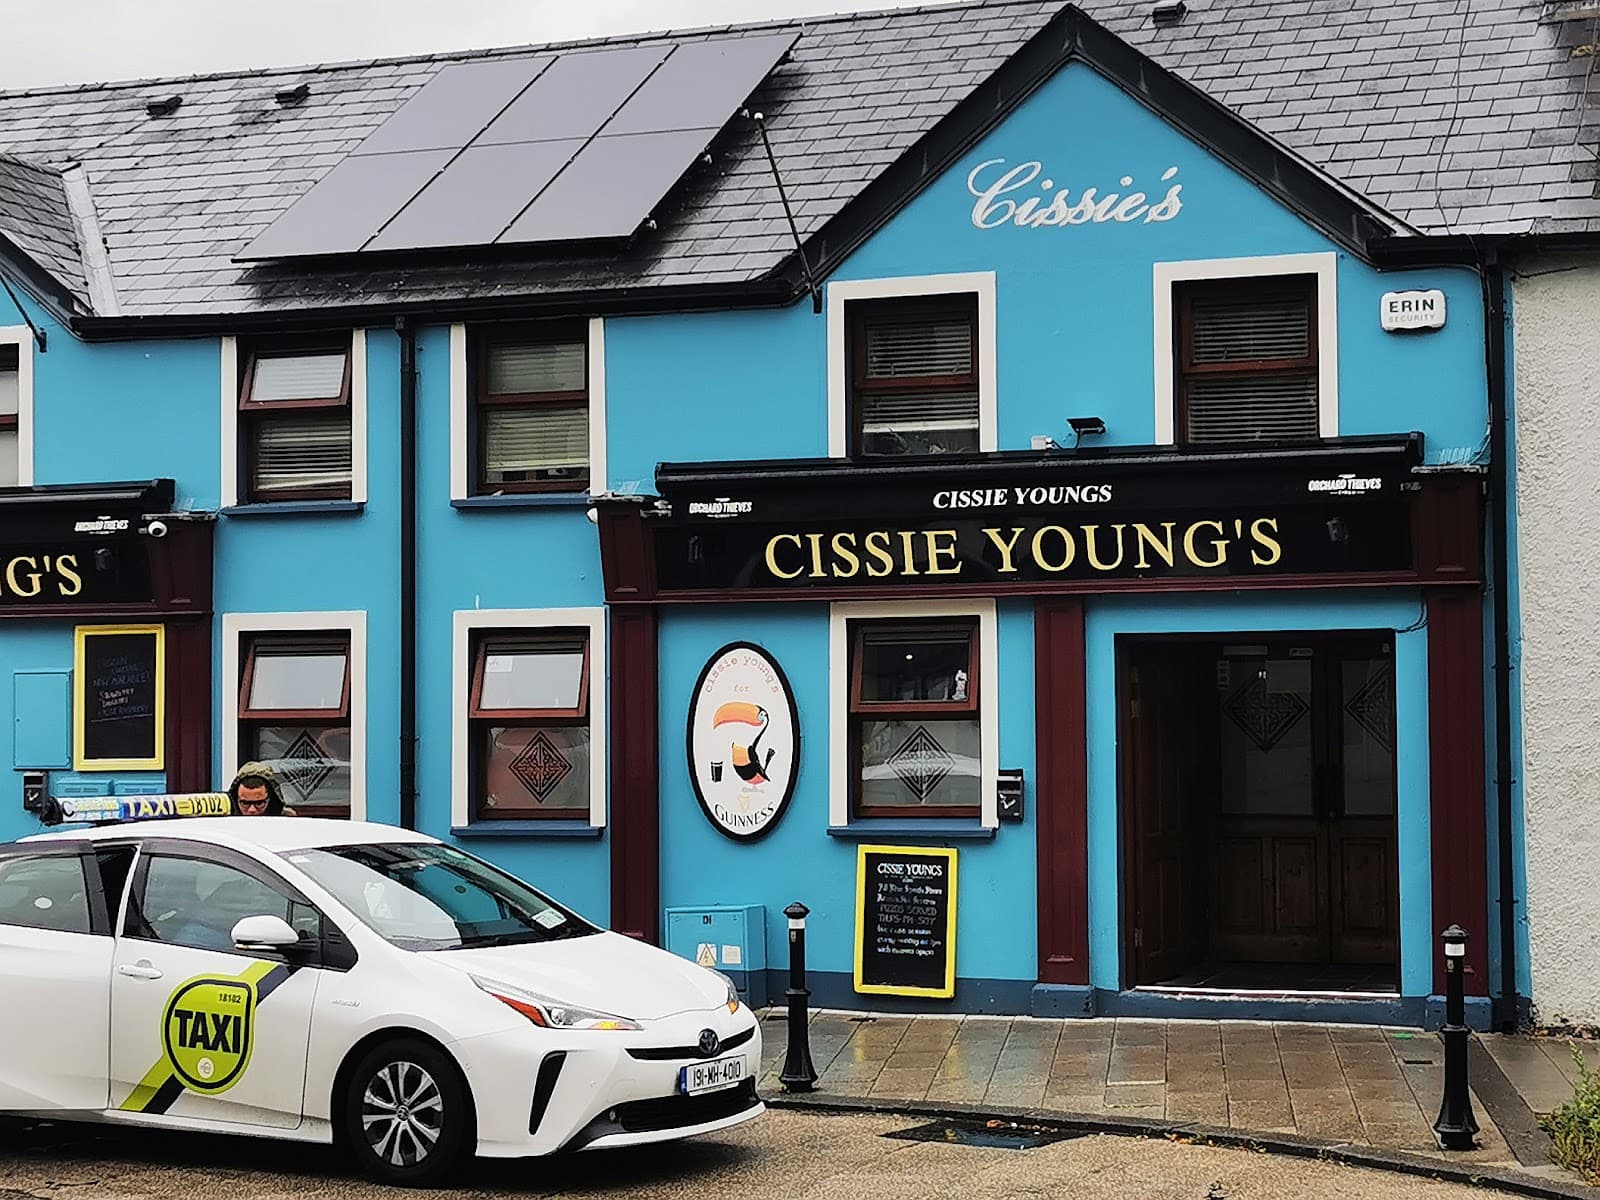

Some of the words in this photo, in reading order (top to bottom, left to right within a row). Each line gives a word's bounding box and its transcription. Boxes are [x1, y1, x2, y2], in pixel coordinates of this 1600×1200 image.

[967, 158, 1183, 229] Cissie's
[1389, 298, 1435, 313] ERIN
[1388, 313, 1436, 323] SECURITY
[1347, 477, 1382, 490] THIEVES
[932, 488, 1008, 509] CISSIE
[1015, 484, 1113, 505] YOUNGS
[765, 530, 963, 579] CISSIE
[982, 517, 1282, 574] YOUNG'S
[0, 554, 82, 598] G'S
[705, 655, 738, 694] cissie
[743, 655, 780, 694] young's
[733, 684, 751, 693] for
[124, 797, 175, 818] TAXI
[188, 795, 223, 815] 18102
[714, 801, 775, 828] GUINNESS
[877, 862, 905, 875] CISSIE
[218, 993, 241, 1004] 18102
[174, 1008, 241, 1054] TAXI
